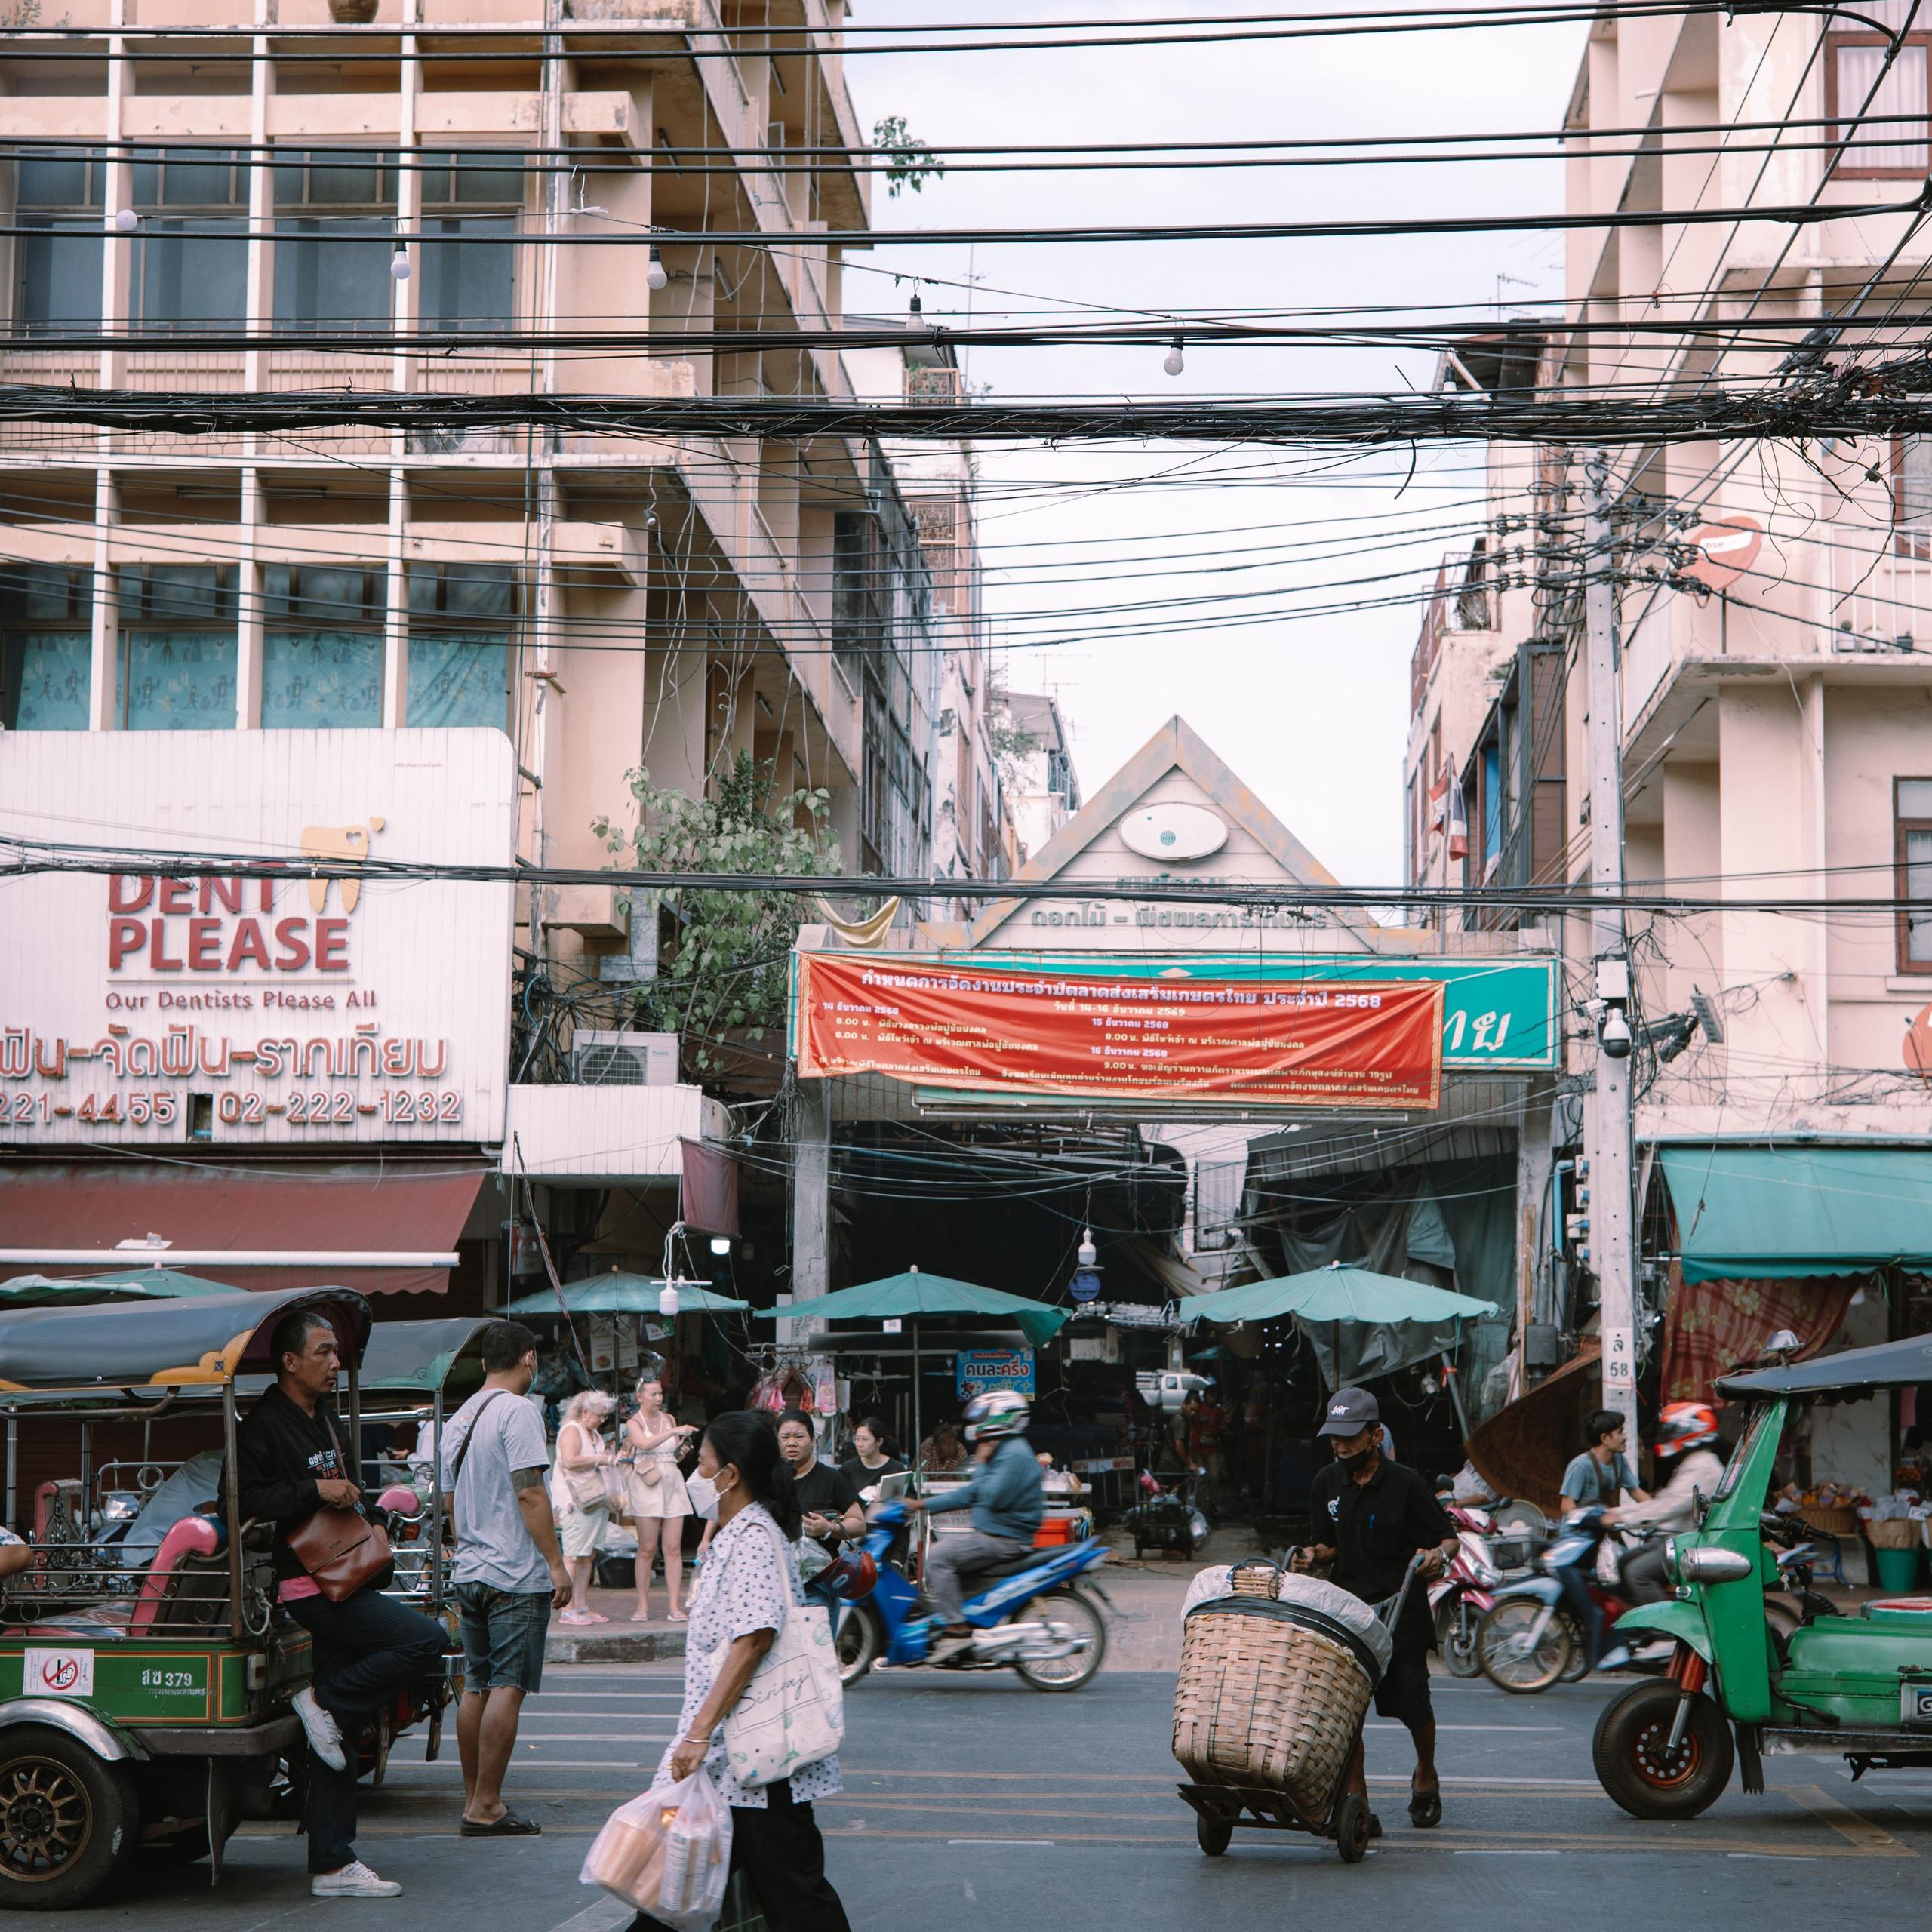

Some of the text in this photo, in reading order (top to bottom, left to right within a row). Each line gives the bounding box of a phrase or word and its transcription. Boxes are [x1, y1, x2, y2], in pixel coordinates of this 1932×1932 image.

[109, 860, 288, 913] DENT
[1032, 903, 1106, 927] ดอกไม้
[109, 918, 350, 970] PLEASE
[106, 989, 378, 1011] Our Dentists Please All
[1054, 998, 1075, 1012] วันที่
[1079, 1004, 1109, 1013] 14-16
[1113, 1004, 1153, 1015] ธันวาคม
[1263, 990, 1328, 1007] ประจำปี
[1334, 994, 1382, 1009] 2568
[823, 1001, 900, 1015] 14 ธันวาคม 2568
[836, 1017, 859, 1026] 8.00
[1091, 1017, 1169, 1029] 15 ธันวาคม 2568
[835, 1032, 858, 1040] 8.00
[923, 1038, 932, 1046] ณ
[1105, 1032, 1128, 1041] 8.00
[1130, 1034, 1139, 1042] น.
[1090, 1045, 1168, 1057] 16 ธันวาคม 2568
[1103, 1061, 1127, 1070] 9.00
[1128, 1063, 1137, 1071] น.
[219, 1090, 462, 1124] 02-222-1232
[965, 1355, 1029, 1377] คนละครึ่ง
[1609, 1362, 1629, 1377] 58
[165, 1672, 192, 1687] 379
